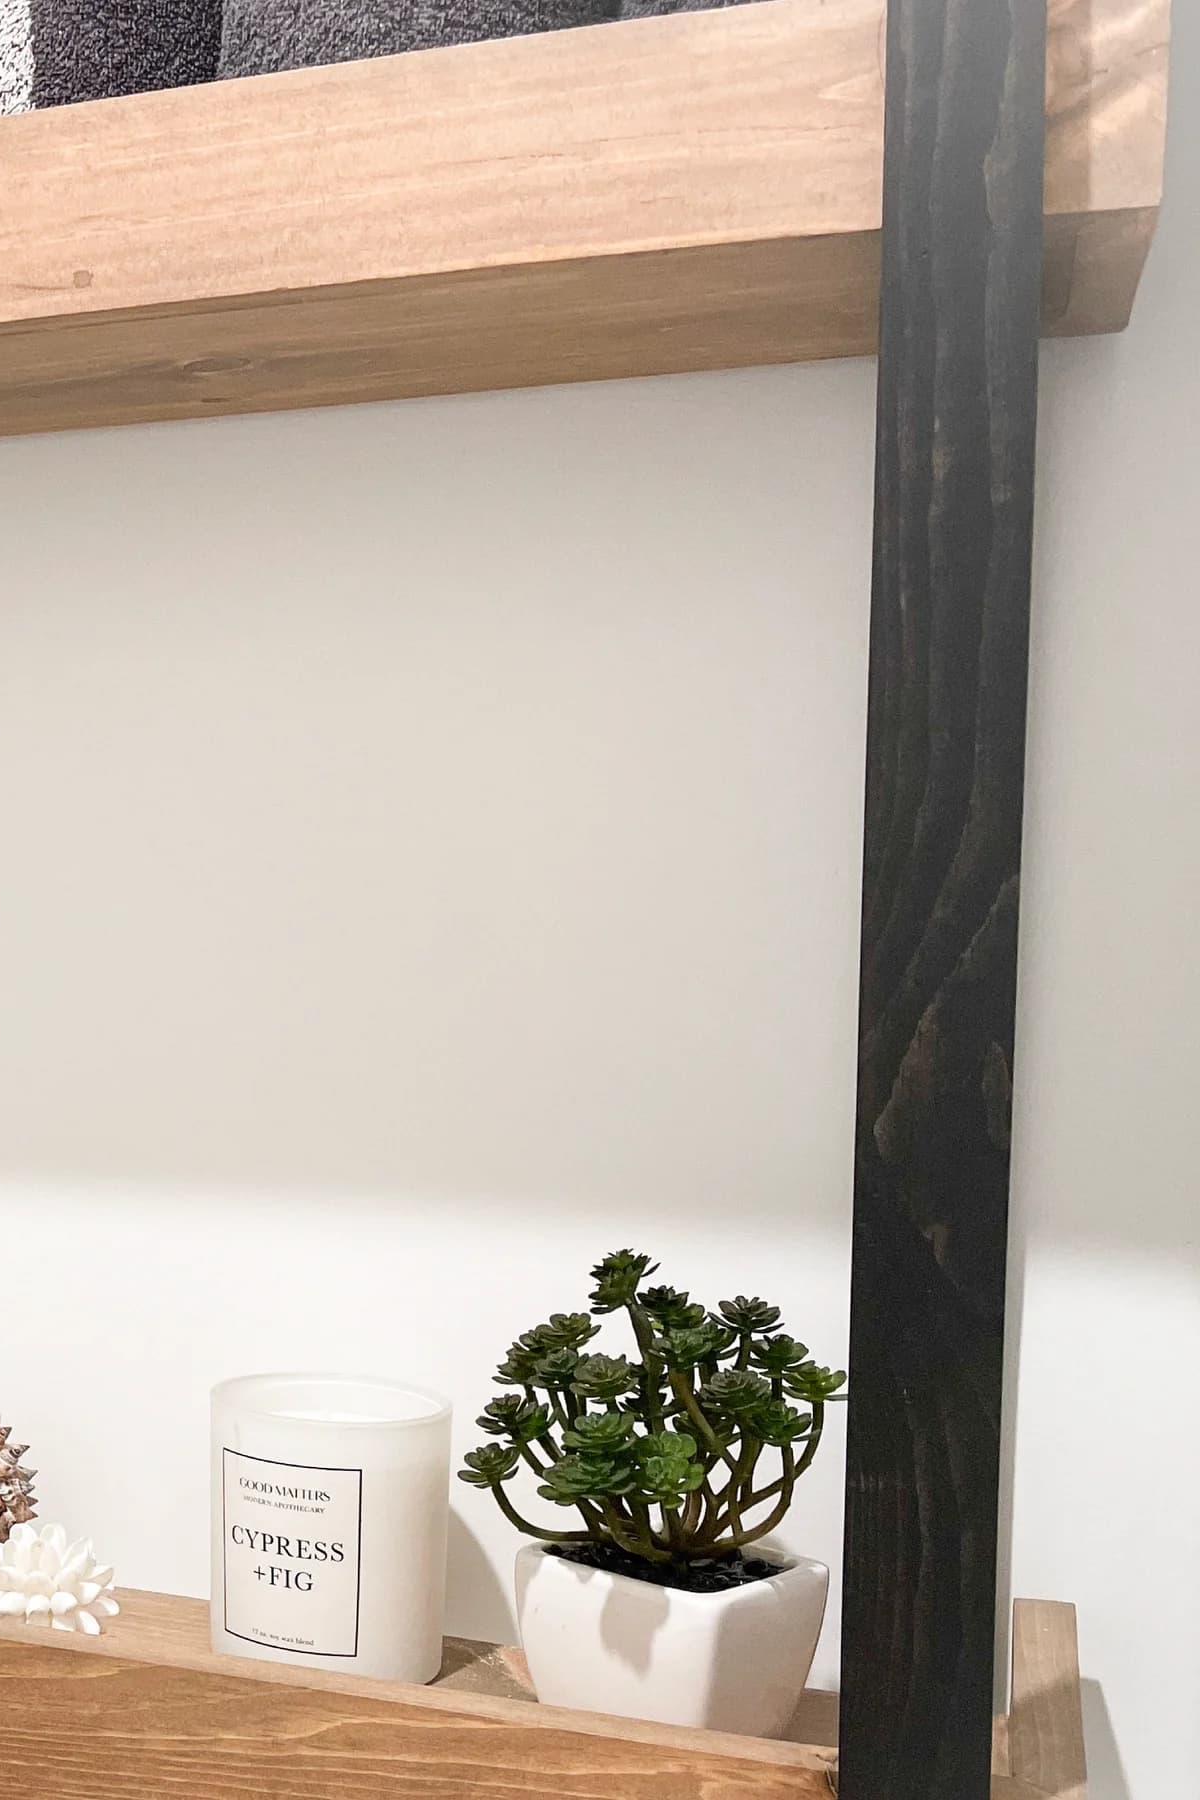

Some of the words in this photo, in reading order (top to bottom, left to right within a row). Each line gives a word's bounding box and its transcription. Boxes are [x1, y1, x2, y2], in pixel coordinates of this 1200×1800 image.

[240, 1477, 273, 1493] GOOD
[275, 1485, 331, 1502] MATTERS
[273, 1501, 326, 1514] APOTHECARY
[232, 1525, 345, 1562] CYPRESS
[253, 1565, 314, 1592] +FIG
